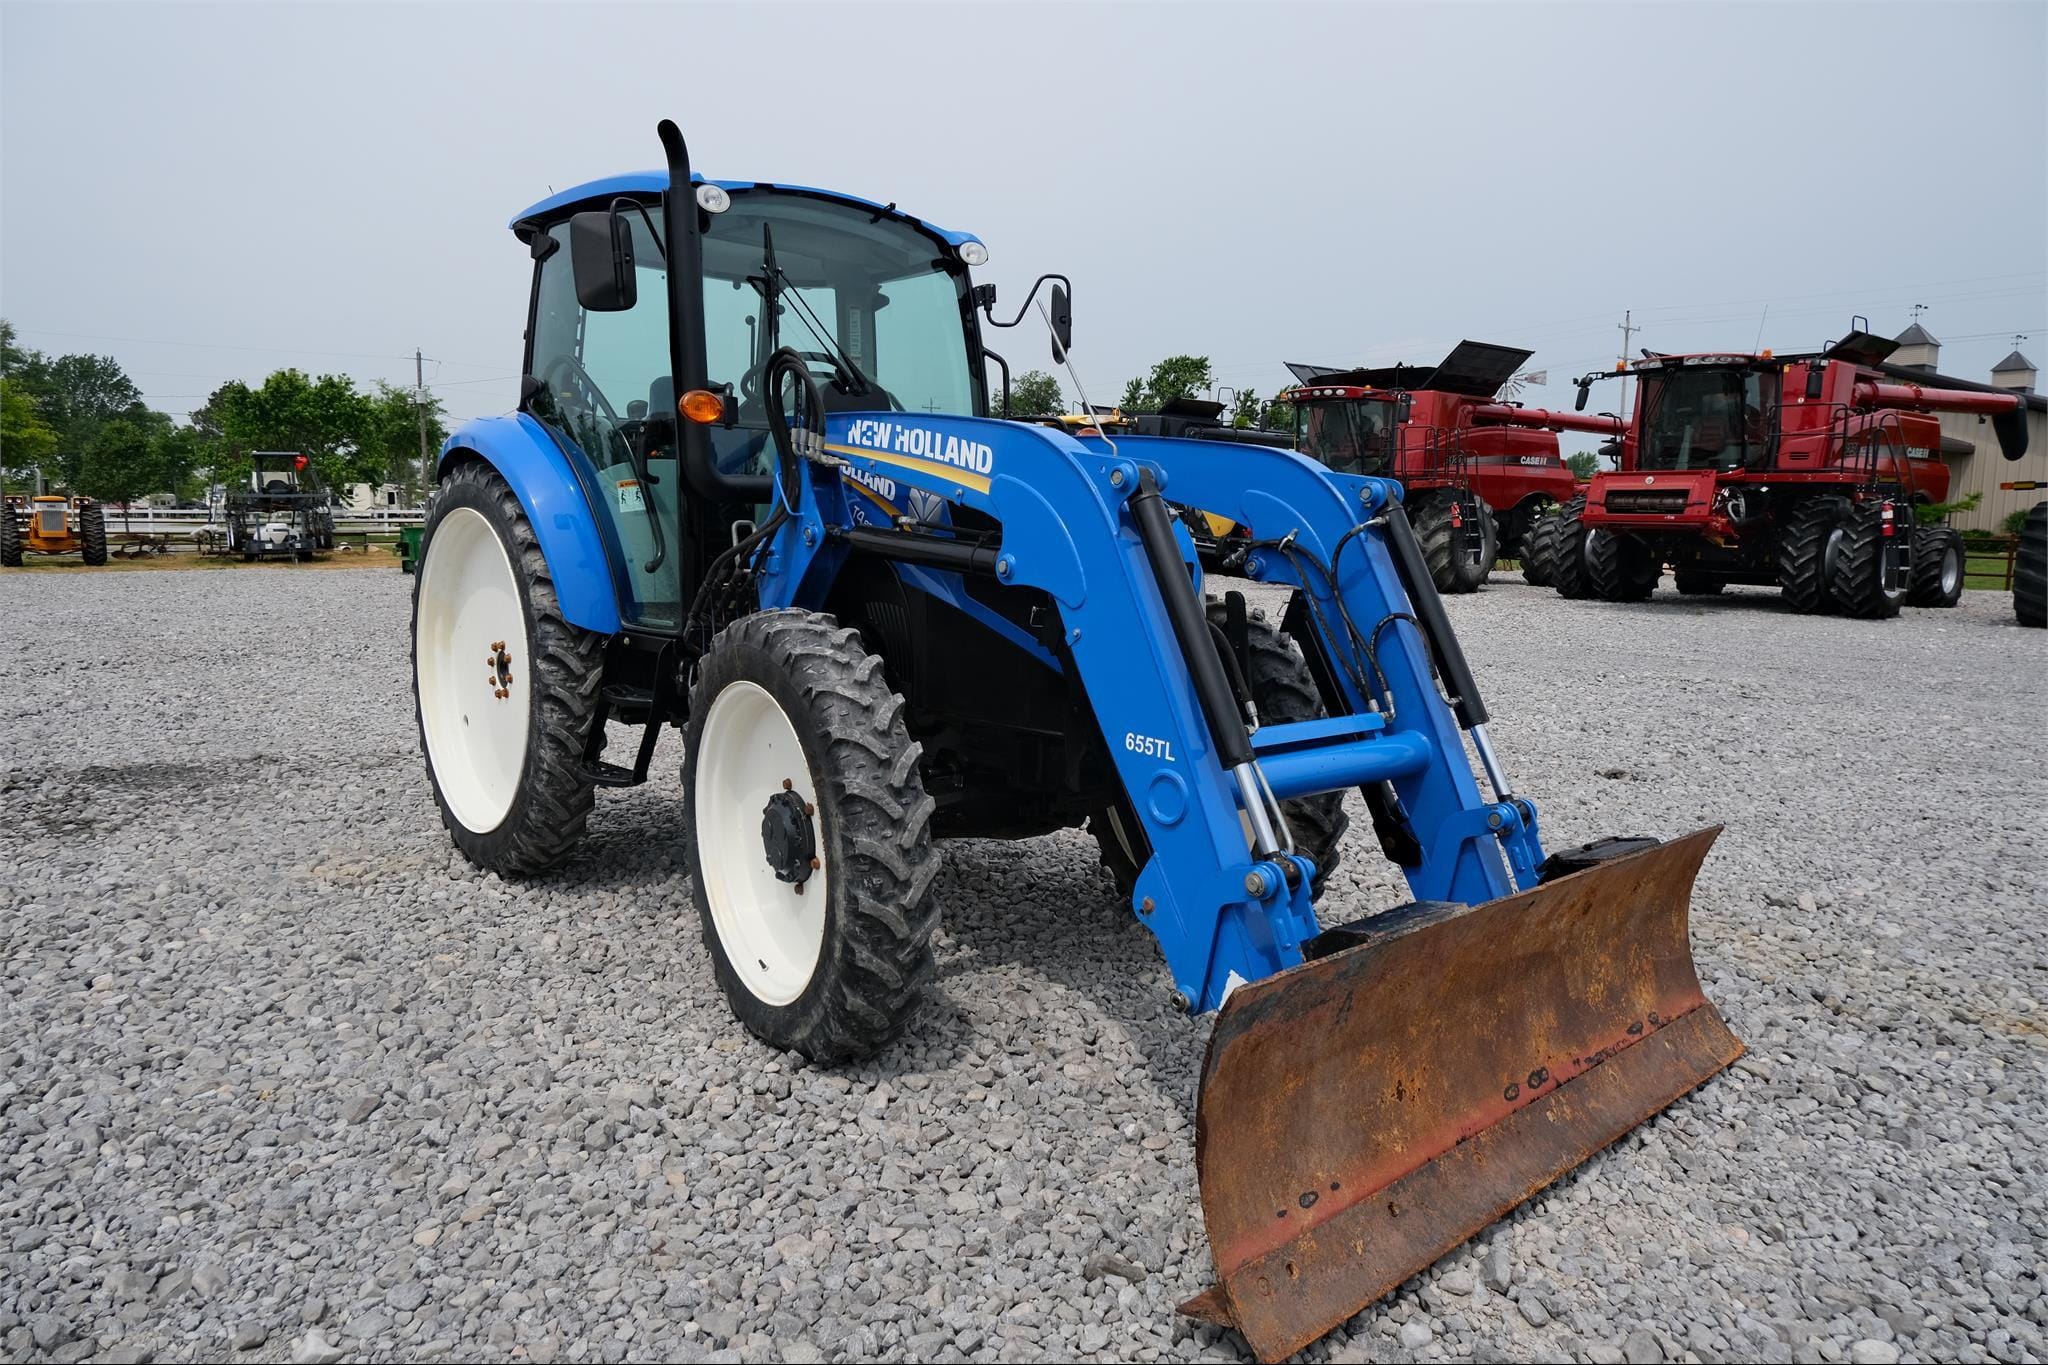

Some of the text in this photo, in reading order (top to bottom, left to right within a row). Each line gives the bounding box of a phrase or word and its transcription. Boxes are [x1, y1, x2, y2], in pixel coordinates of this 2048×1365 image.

[848, 419, 993, 474] NEW HOLLAND
[840, 464, 896, 501] OLLAND
[1125, 732, 1176, 762] 655TL
